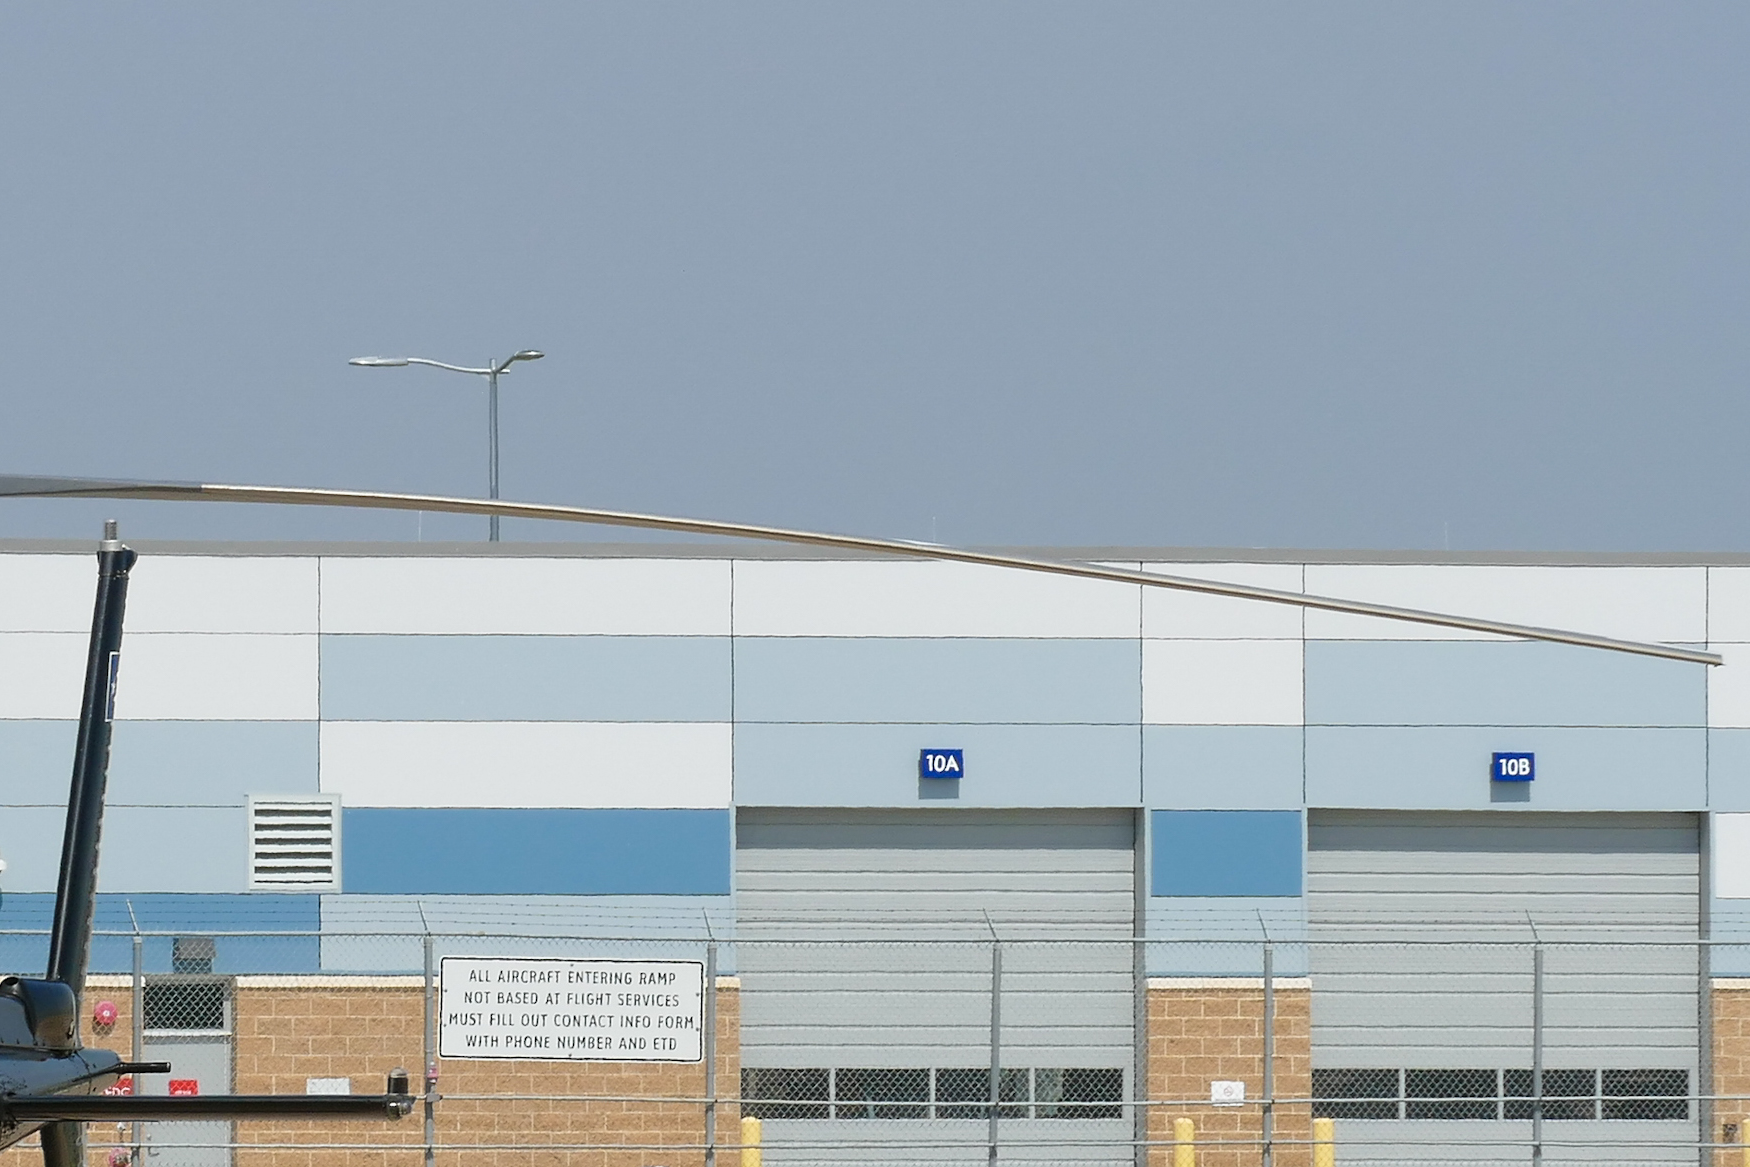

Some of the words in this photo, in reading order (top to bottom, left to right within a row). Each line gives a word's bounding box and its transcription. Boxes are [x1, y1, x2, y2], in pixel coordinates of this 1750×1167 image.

[926, 754, 960, 772] 10A
[1499, 758, 1530, 776] 10B
[469, 969, 491, 983] ALL
[497, 970, 561, 984] AIRCRAFT
[568, 970, 632, 985] ENTERING
[638, 972, 676, 985] RAMP
[464, 991, 491, 1004] NOT
[497, 991, 538, 1004] BASED
[545, 992, 560, 1005] AT
[566, 992, 612, 1006] FLIGHT
[617, 993, 680, 1007] SERVICES
[449, 1013, 483, 1026] MUST
[489, 1013, 515, 1026] FILL
[521, 1013, 548, 1027] OUT
[553, 1014, 614, 1028] CONTACT
[620, 1015, 651, 1028] INFO
[657, 1015, 694, 1029] FORM
[466, 1034, 499, 1047] WITH
[505, 1035, 550, 1048] PHONE
[557, 1036, 612, 1050] NUMBER
[618, 1037, 647, 1050] AND
[653, 1037, 677, 1050] ETD
